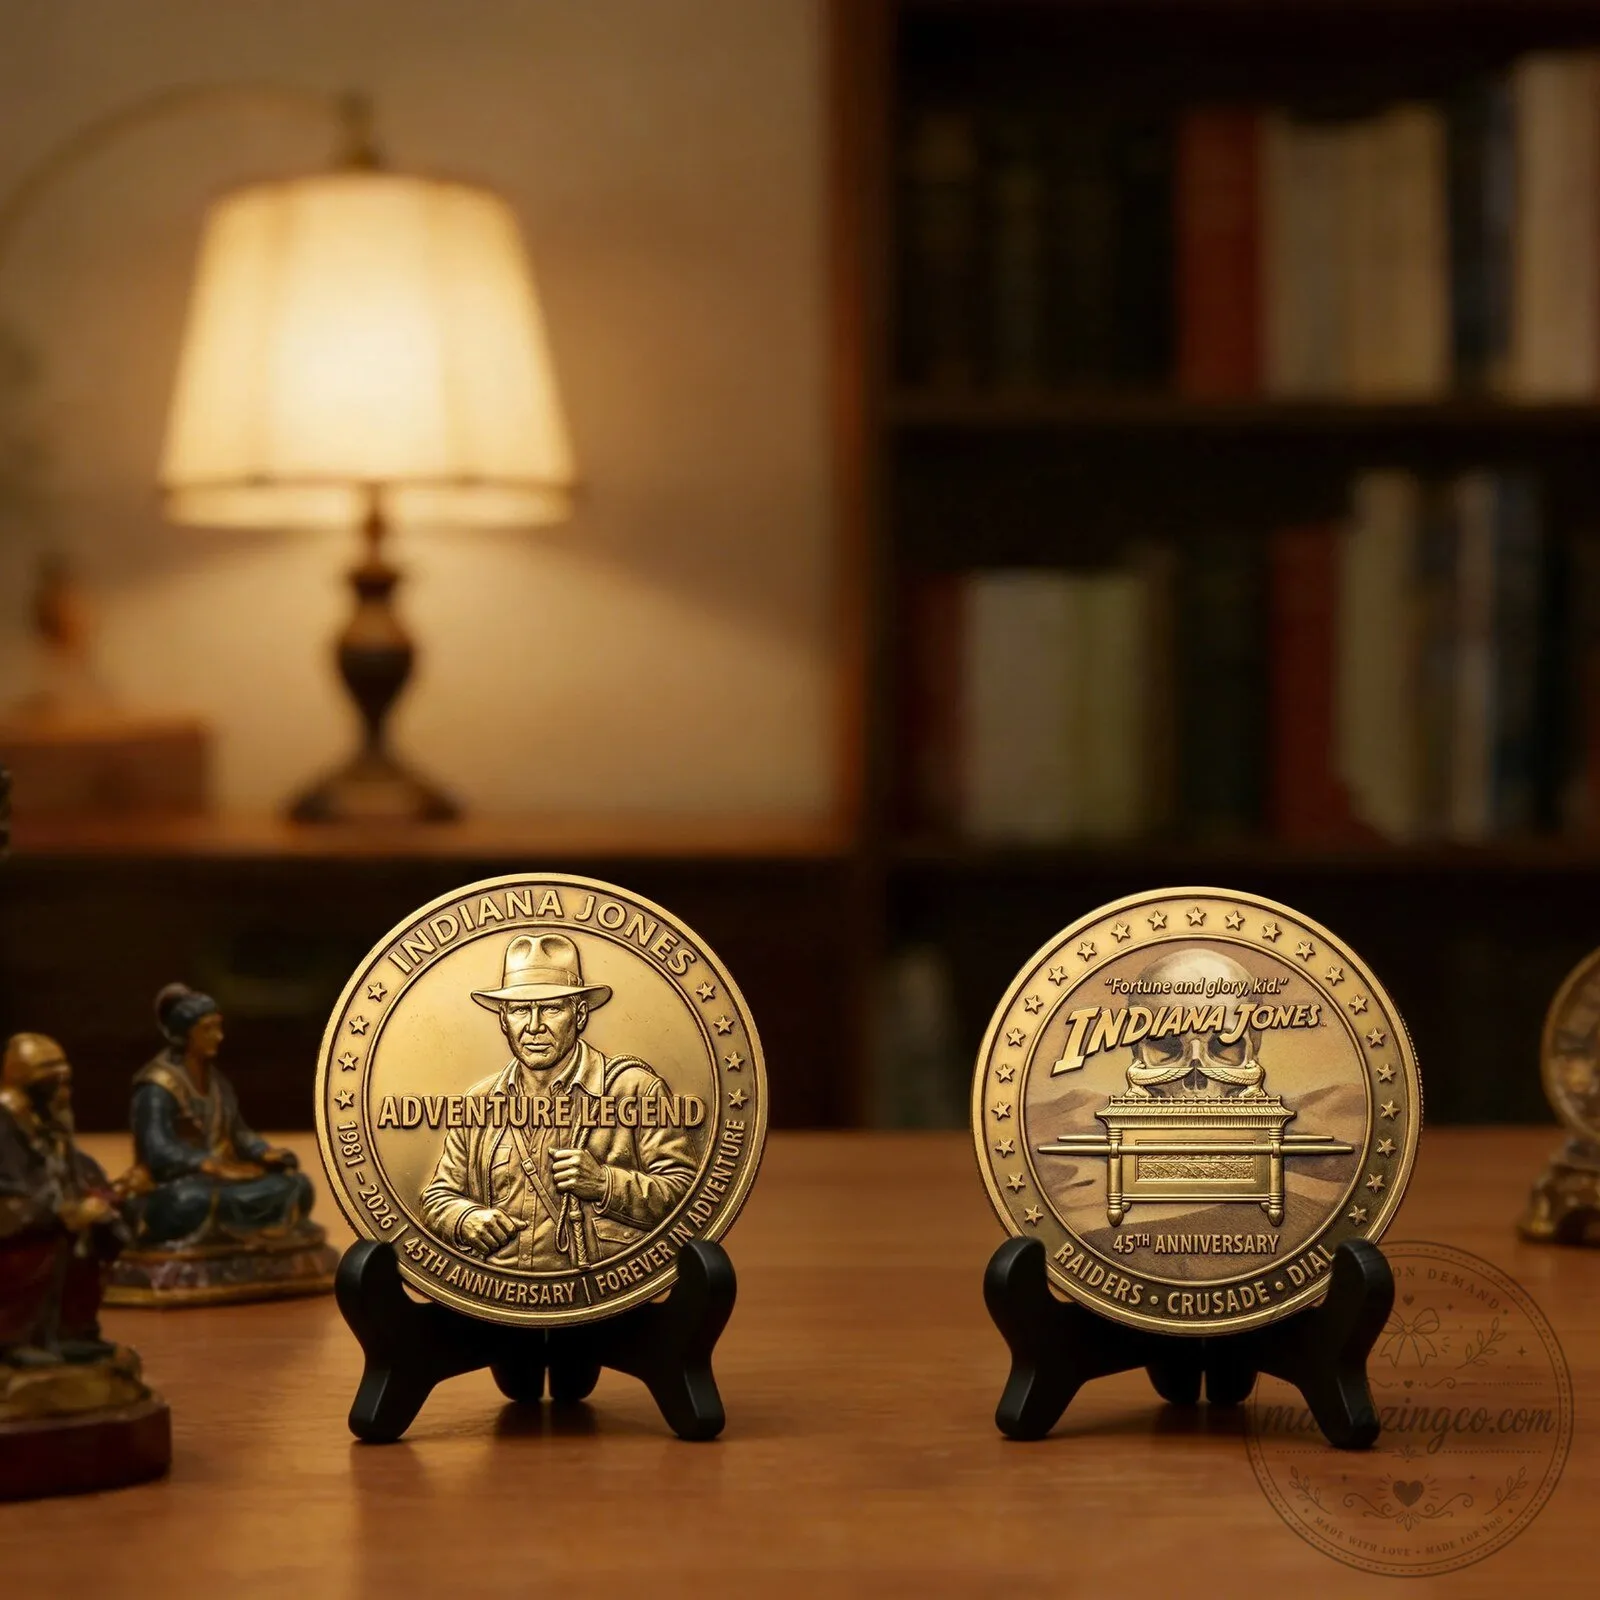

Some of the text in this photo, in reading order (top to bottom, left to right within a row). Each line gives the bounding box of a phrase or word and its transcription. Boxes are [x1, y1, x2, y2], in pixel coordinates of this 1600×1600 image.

[388, 890, 698, 976] INDIANA JONES
[1174, 978, 1204, 994] and
[1206, 977, 1249, 998] glory,
[1050, 1003, 1321, 1076] INDIANA JONES
[377, 1095, 706, 1129] ADVENTURE LEGEND
[337, 1120, 366, 1167] 1981
[358, 1183, 398, 1231] 2026
[403, 1236, 450, 1276] 45TH
[447, 1264, 576, 1305] ANNIVERSARY
[595, 1239, 677, 1296] FOREVER
[668, 1223, 695, 1248] IN
[690, 1118, 746, 1230] ADVENTURE
[1113, 1234, 1281, 1254] 45TH ANNIVERSARY
[1053, 1241, 1337, 1316] RAIDERS CRUSADE DIAL
